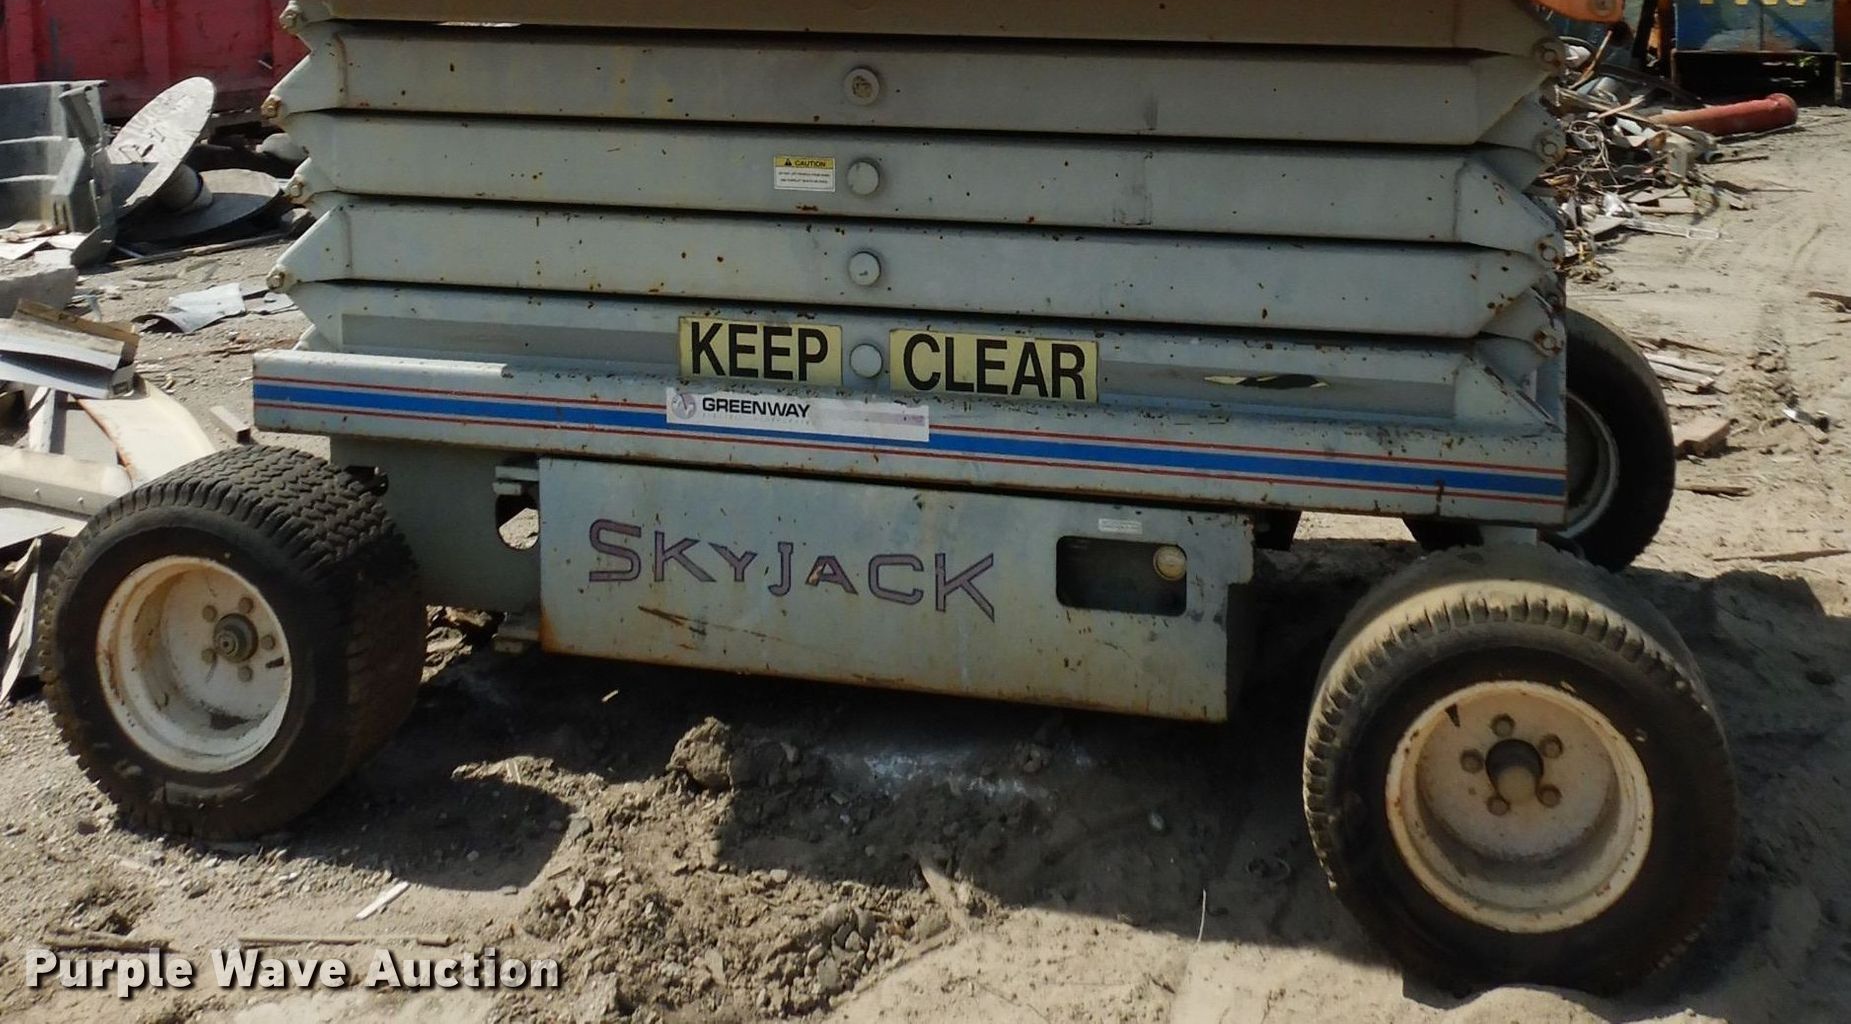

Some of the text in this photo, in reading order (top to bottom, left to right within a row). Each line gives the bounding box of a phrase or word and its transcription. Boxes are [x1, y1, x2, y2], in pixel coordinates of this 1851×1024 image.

[794, 159, 826, 168] CAUTION
[691, 321, 1086, 401] KEEP CLEAR
[702, 397, 811, 419] GREENWAY
